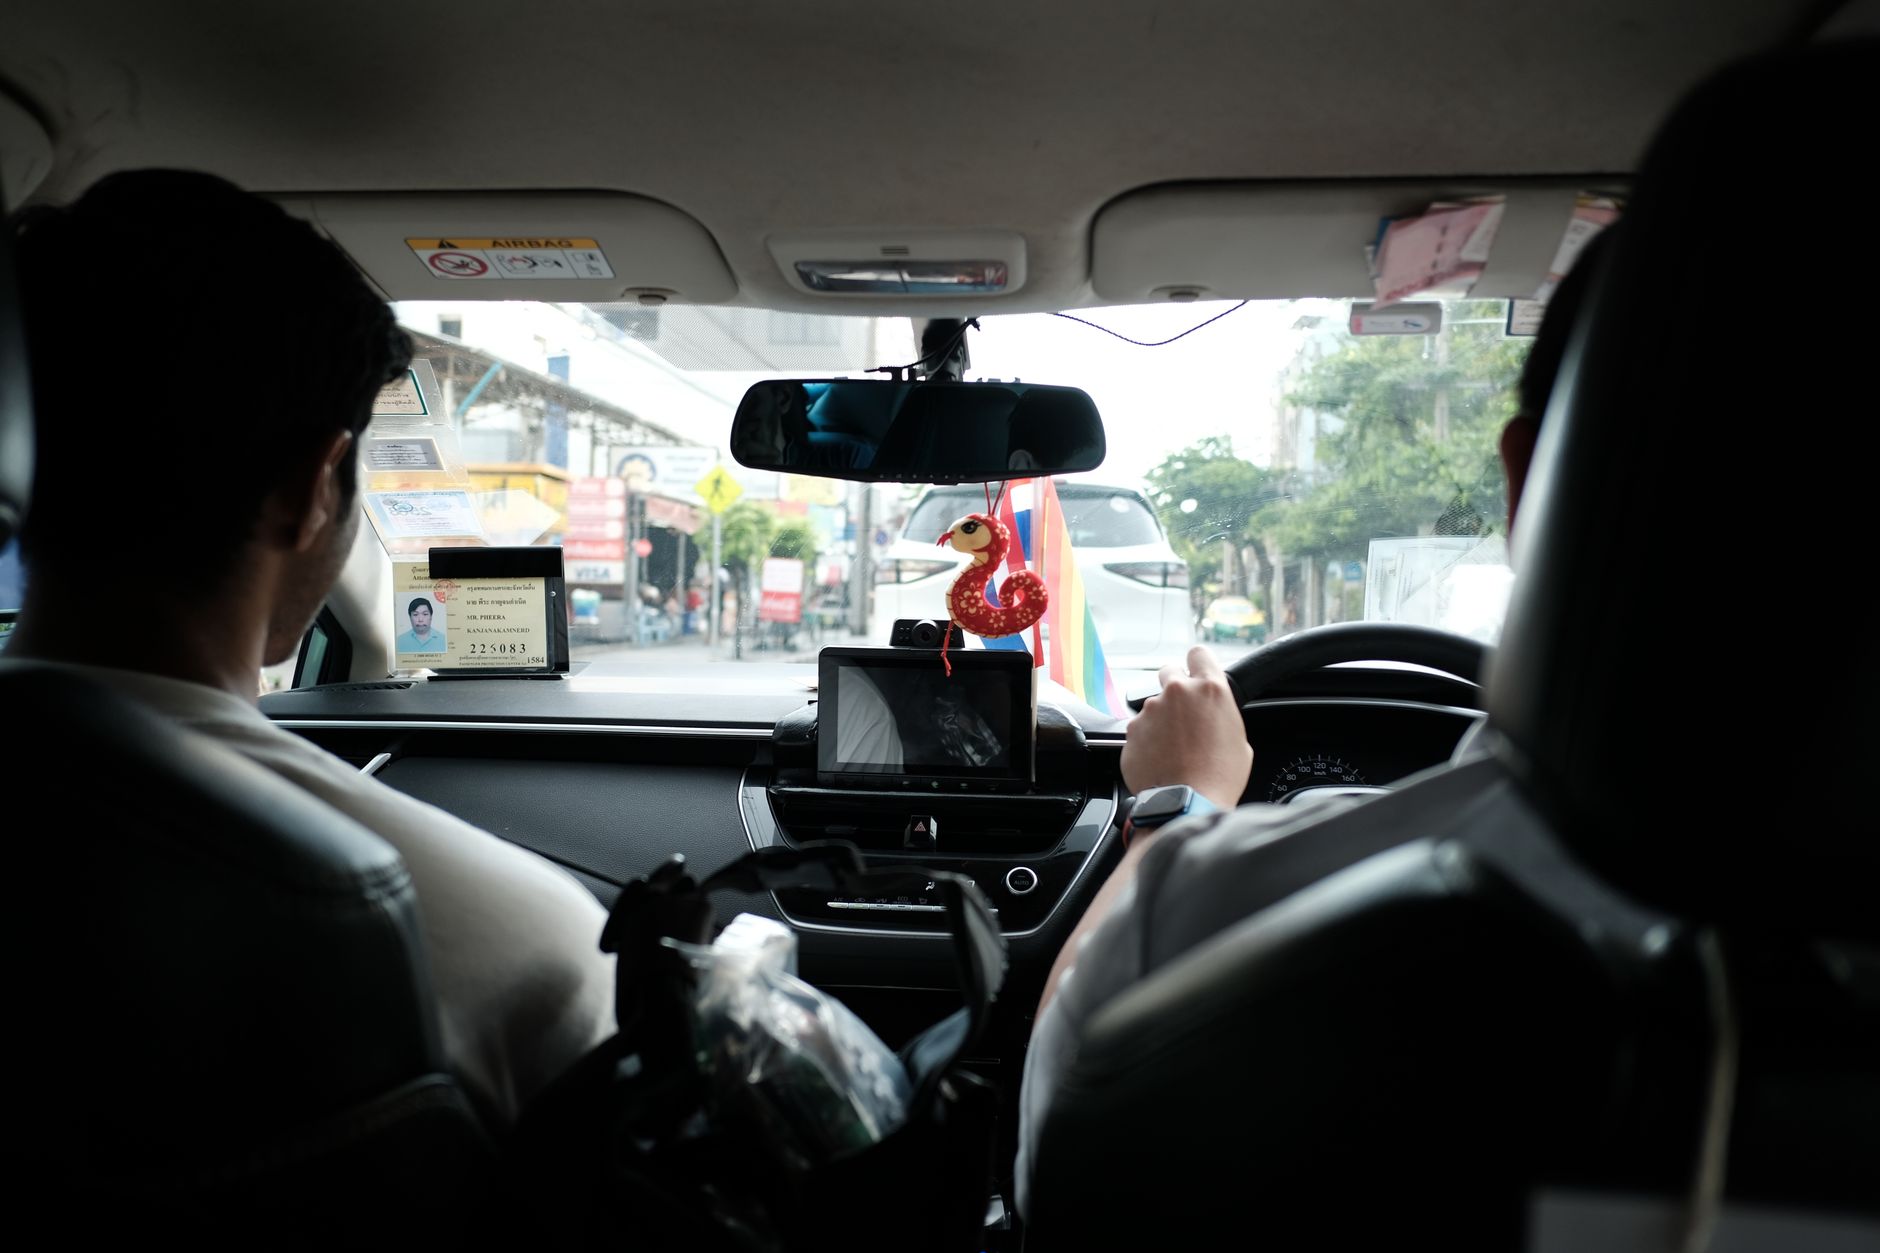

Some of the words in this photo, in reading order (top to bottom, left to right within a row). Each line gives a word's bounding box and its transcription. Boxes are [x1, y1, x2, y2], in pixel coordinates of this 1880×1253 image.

[491, 239, 574, 249] AIRBAG
[575, 567, 610, 579] VISA
[527, 656, 545, 664] 1584
[1286, 773, 1297, 781] 80
[1277, 784, 1288, 792] 60
